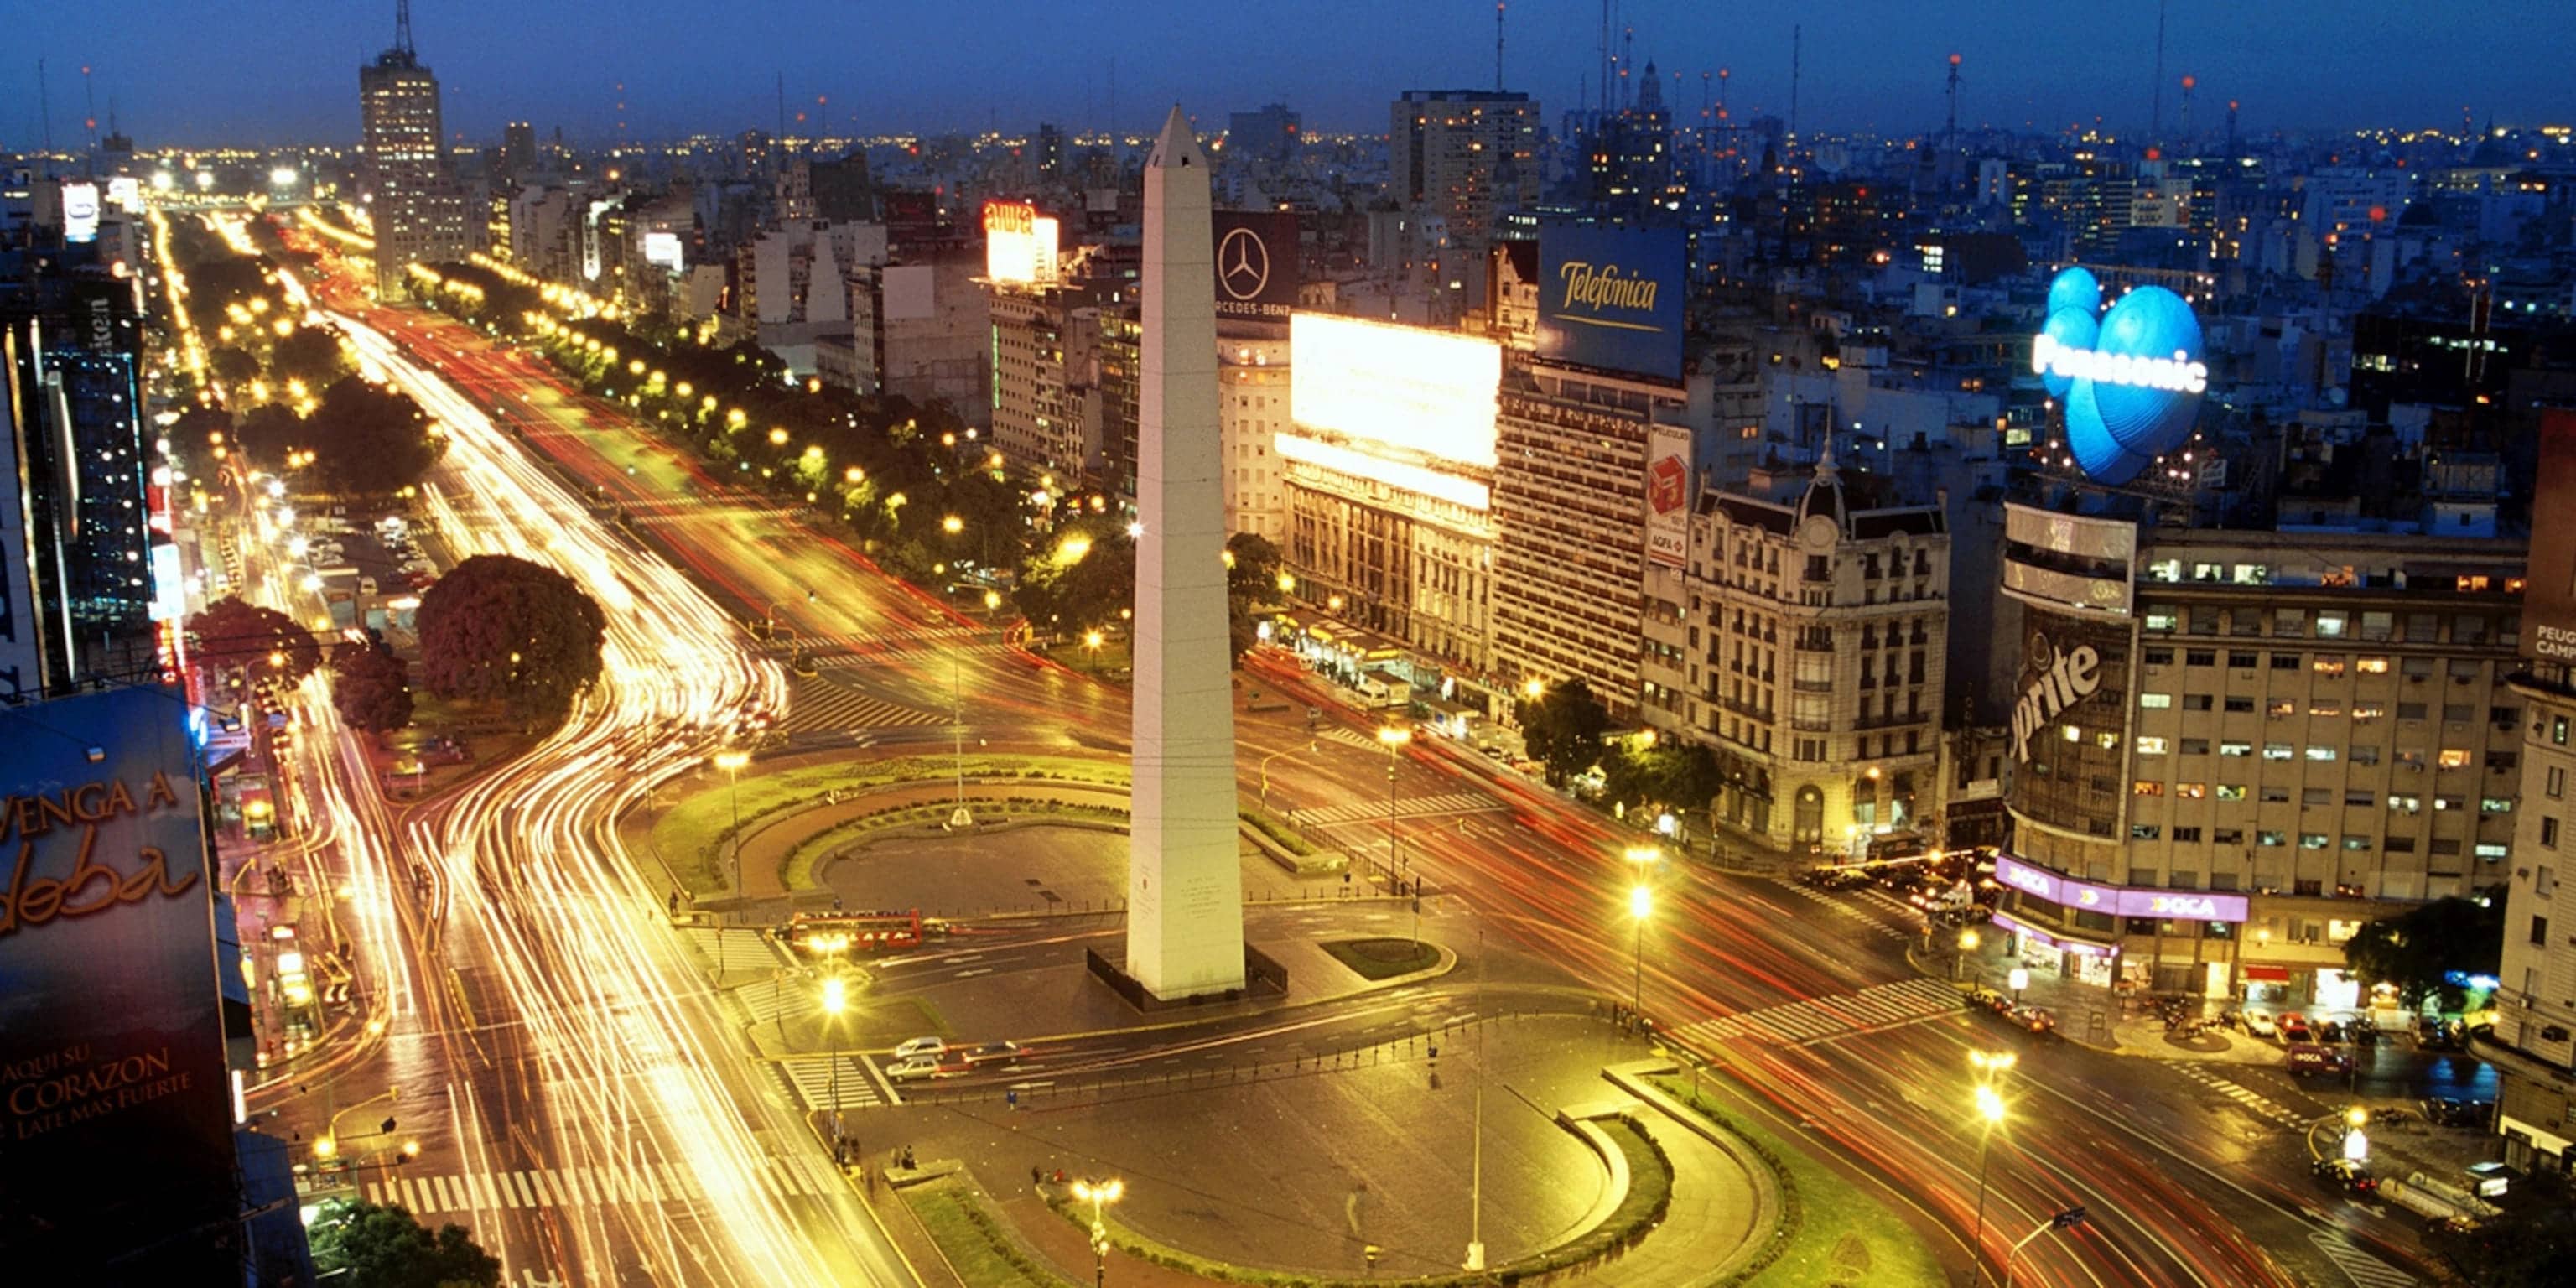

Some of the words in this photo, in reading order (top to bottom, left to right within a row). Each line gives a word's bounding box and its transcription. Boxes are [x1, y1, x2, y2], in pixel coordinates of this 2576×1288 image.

[2033, 334, 2208, 393] Panasonic
[148, 770, 176, 808] A
[9, 1046, 170, 1116] CORAZON
[16, 1111, 64, 1140] LATE
[117, 1072, 192, 1109] FUERTE
